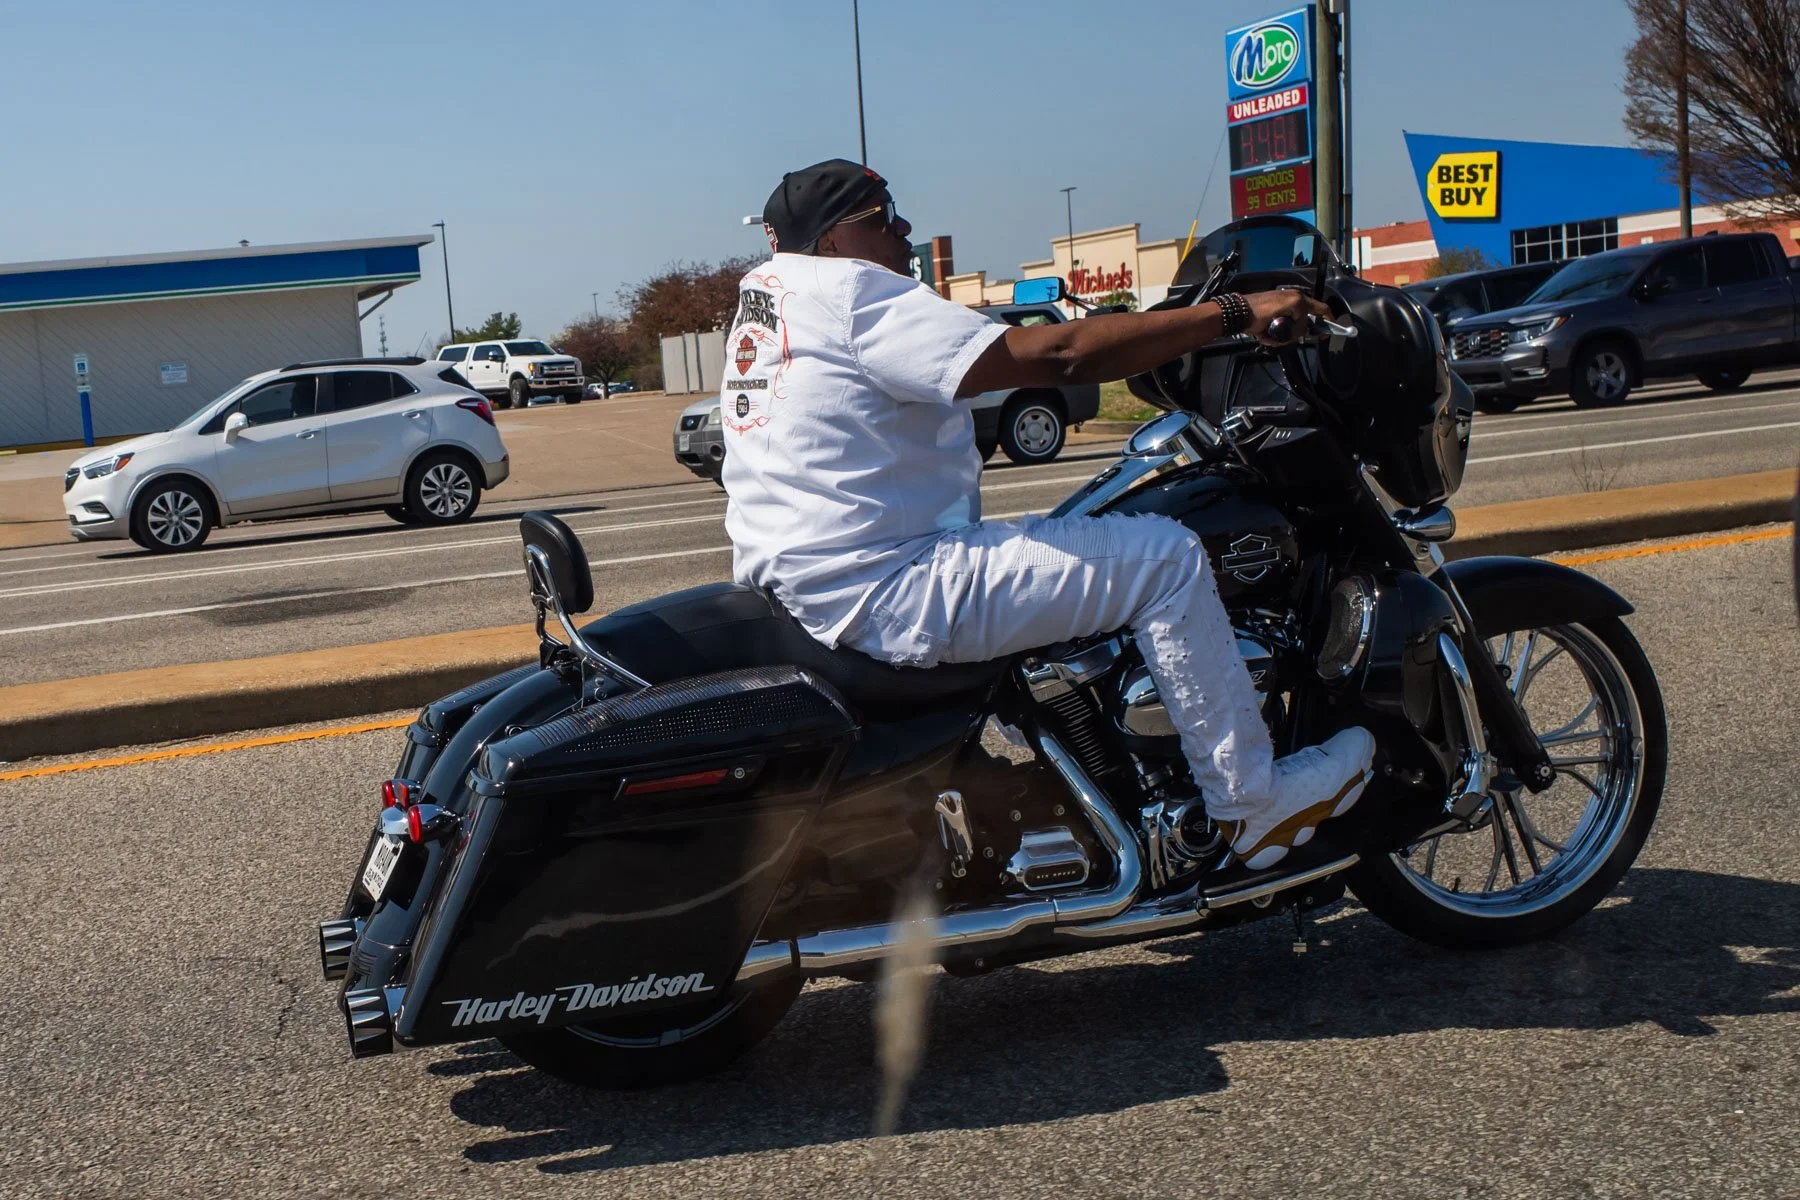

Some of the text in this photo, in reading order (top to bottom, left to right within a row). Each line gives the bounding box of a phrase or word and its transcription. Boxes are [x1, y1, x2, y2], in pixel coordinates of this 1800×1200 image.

[1233, 89, 1300, 119] UNLEADED
[1245, 170, 1295, 192] CORNDOGS
[1437, 164, 1493, 184] BEST
[1265, 188, 1296, 208] CENTS
[1440, 187, 1488, 206] BUY
[1065, 262, 1132, 294] Michaels
[441, 972, 714, 1027] Harley-Davidson
